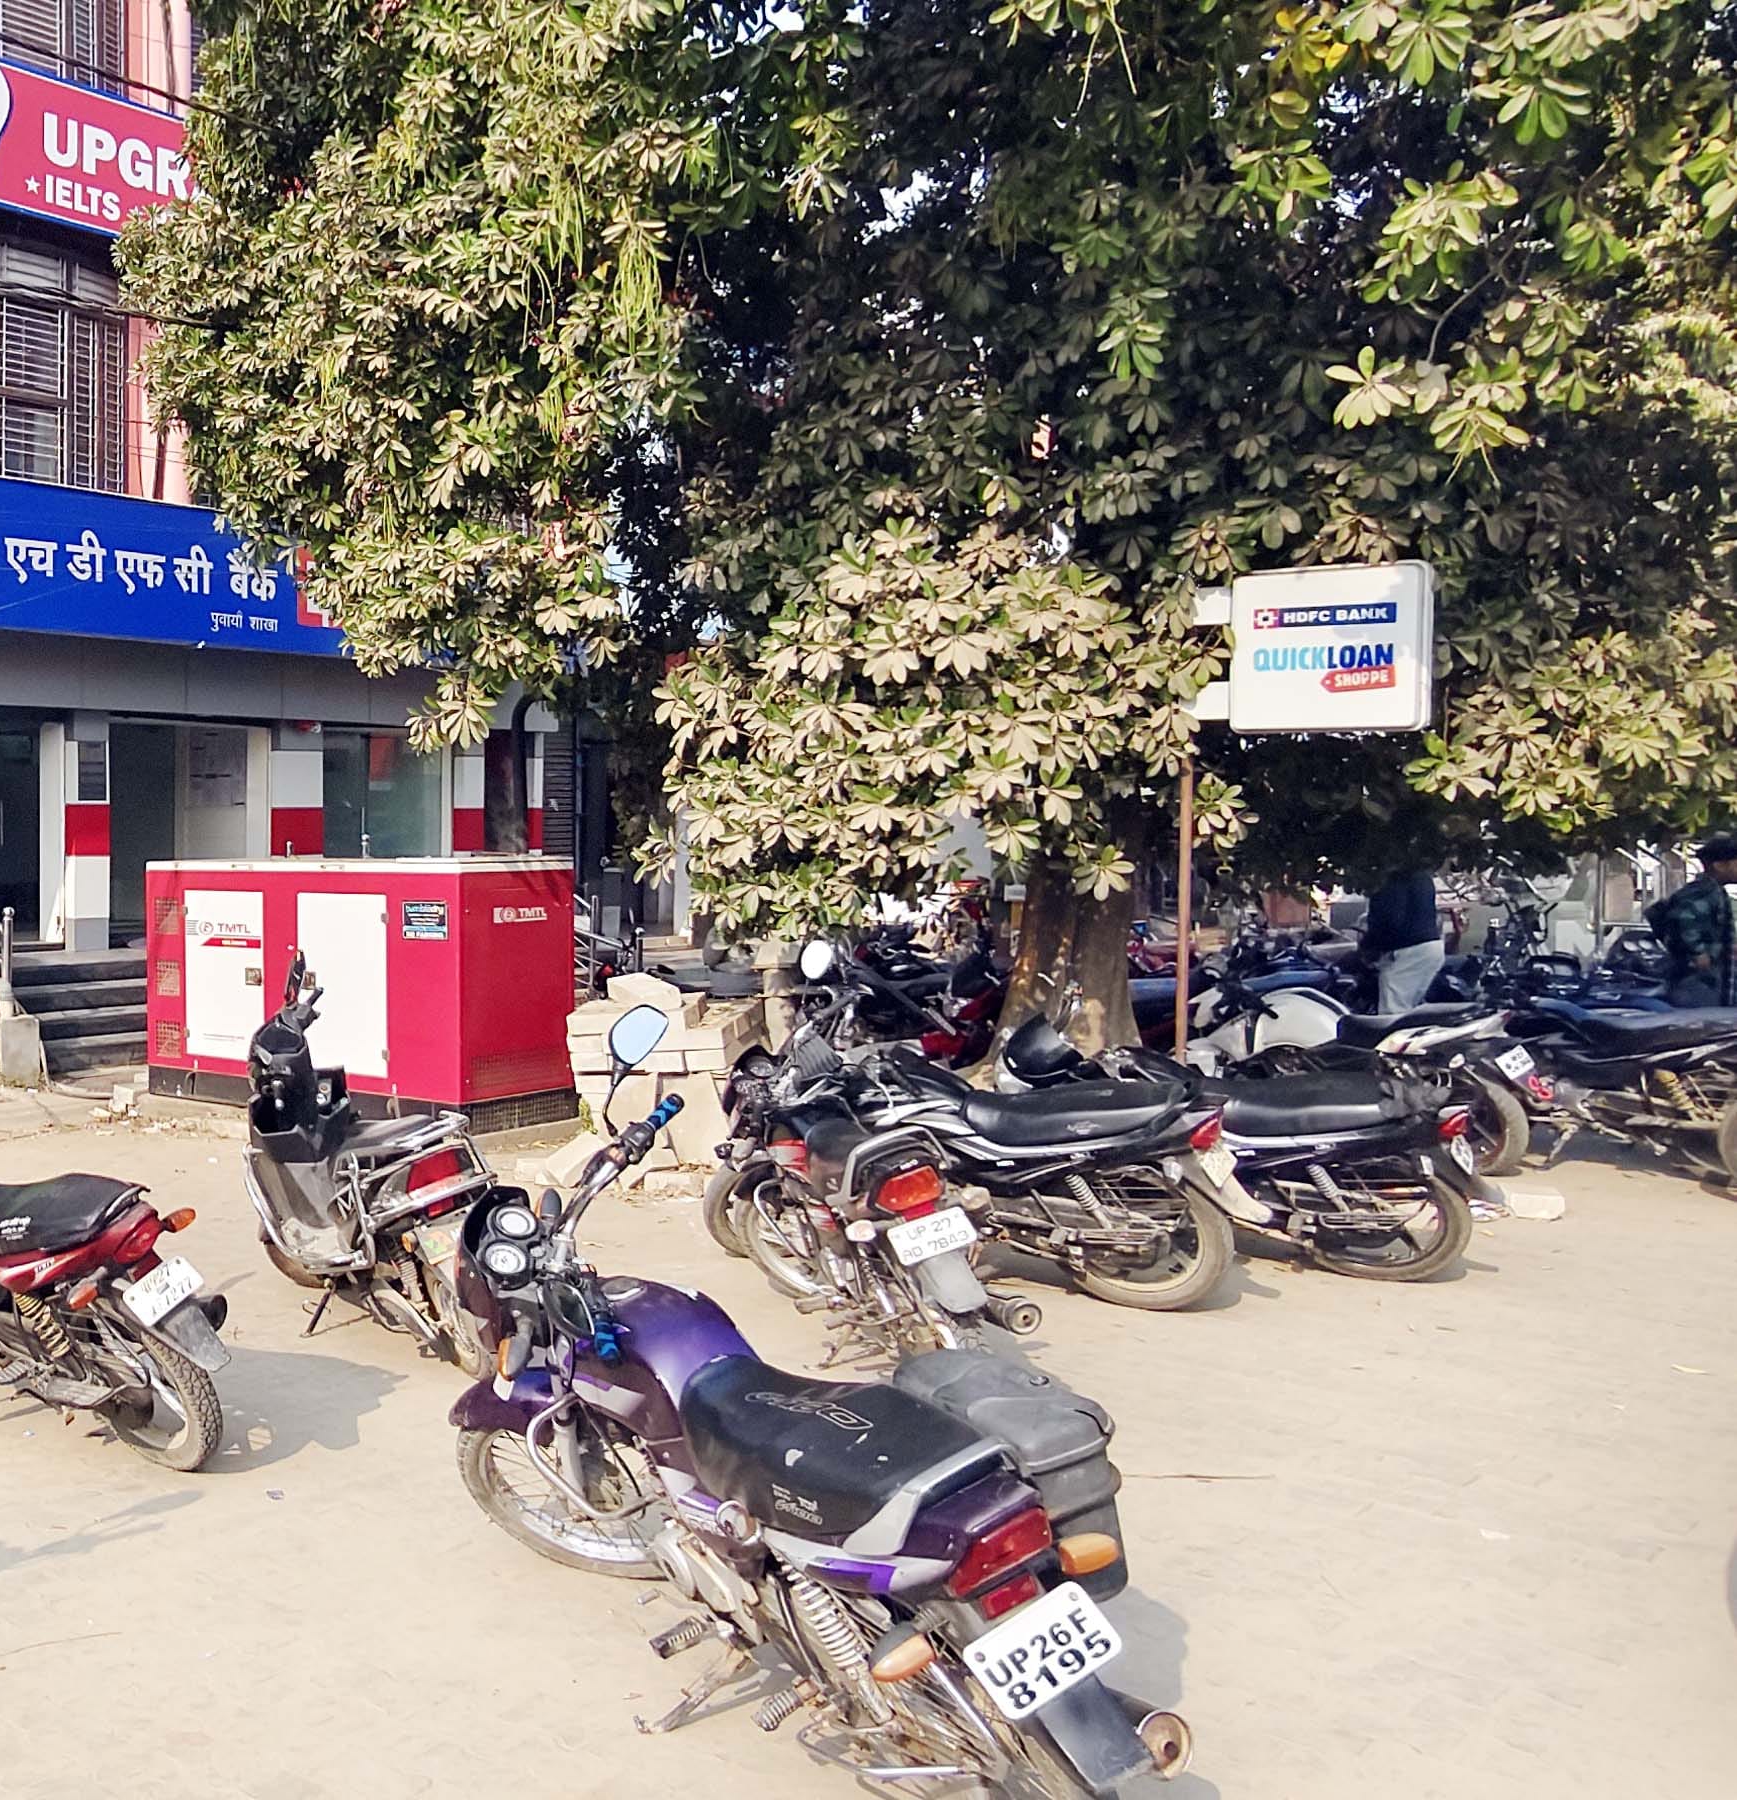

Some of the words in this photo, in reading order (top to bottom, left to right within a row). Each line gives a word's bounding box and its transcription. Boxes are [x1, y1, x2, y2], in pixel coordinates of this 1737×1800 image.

[45, 174, 121, 222] IELTS
[5, 535, 58, 584] एच
[65, 529, 108, 583] डी
[114, 549, 165, 595] एफ
[173, 545, 214, 595] सी
[248, 615, 279, 632] शाखा
[1282, 609, 1331, 624] HDFC
[1335, 606, 1388, 622] BANK
[1334, 668, 1389, 688] SHOPPE
[518, 907, 548, 919] TMTL
[217, 922, 251, 934] TMTL
[905, 1225, 927, 1241] UP
[930, 1217, 952, 1233] 27
[1007, 1629, 1112, 1710] 8195
